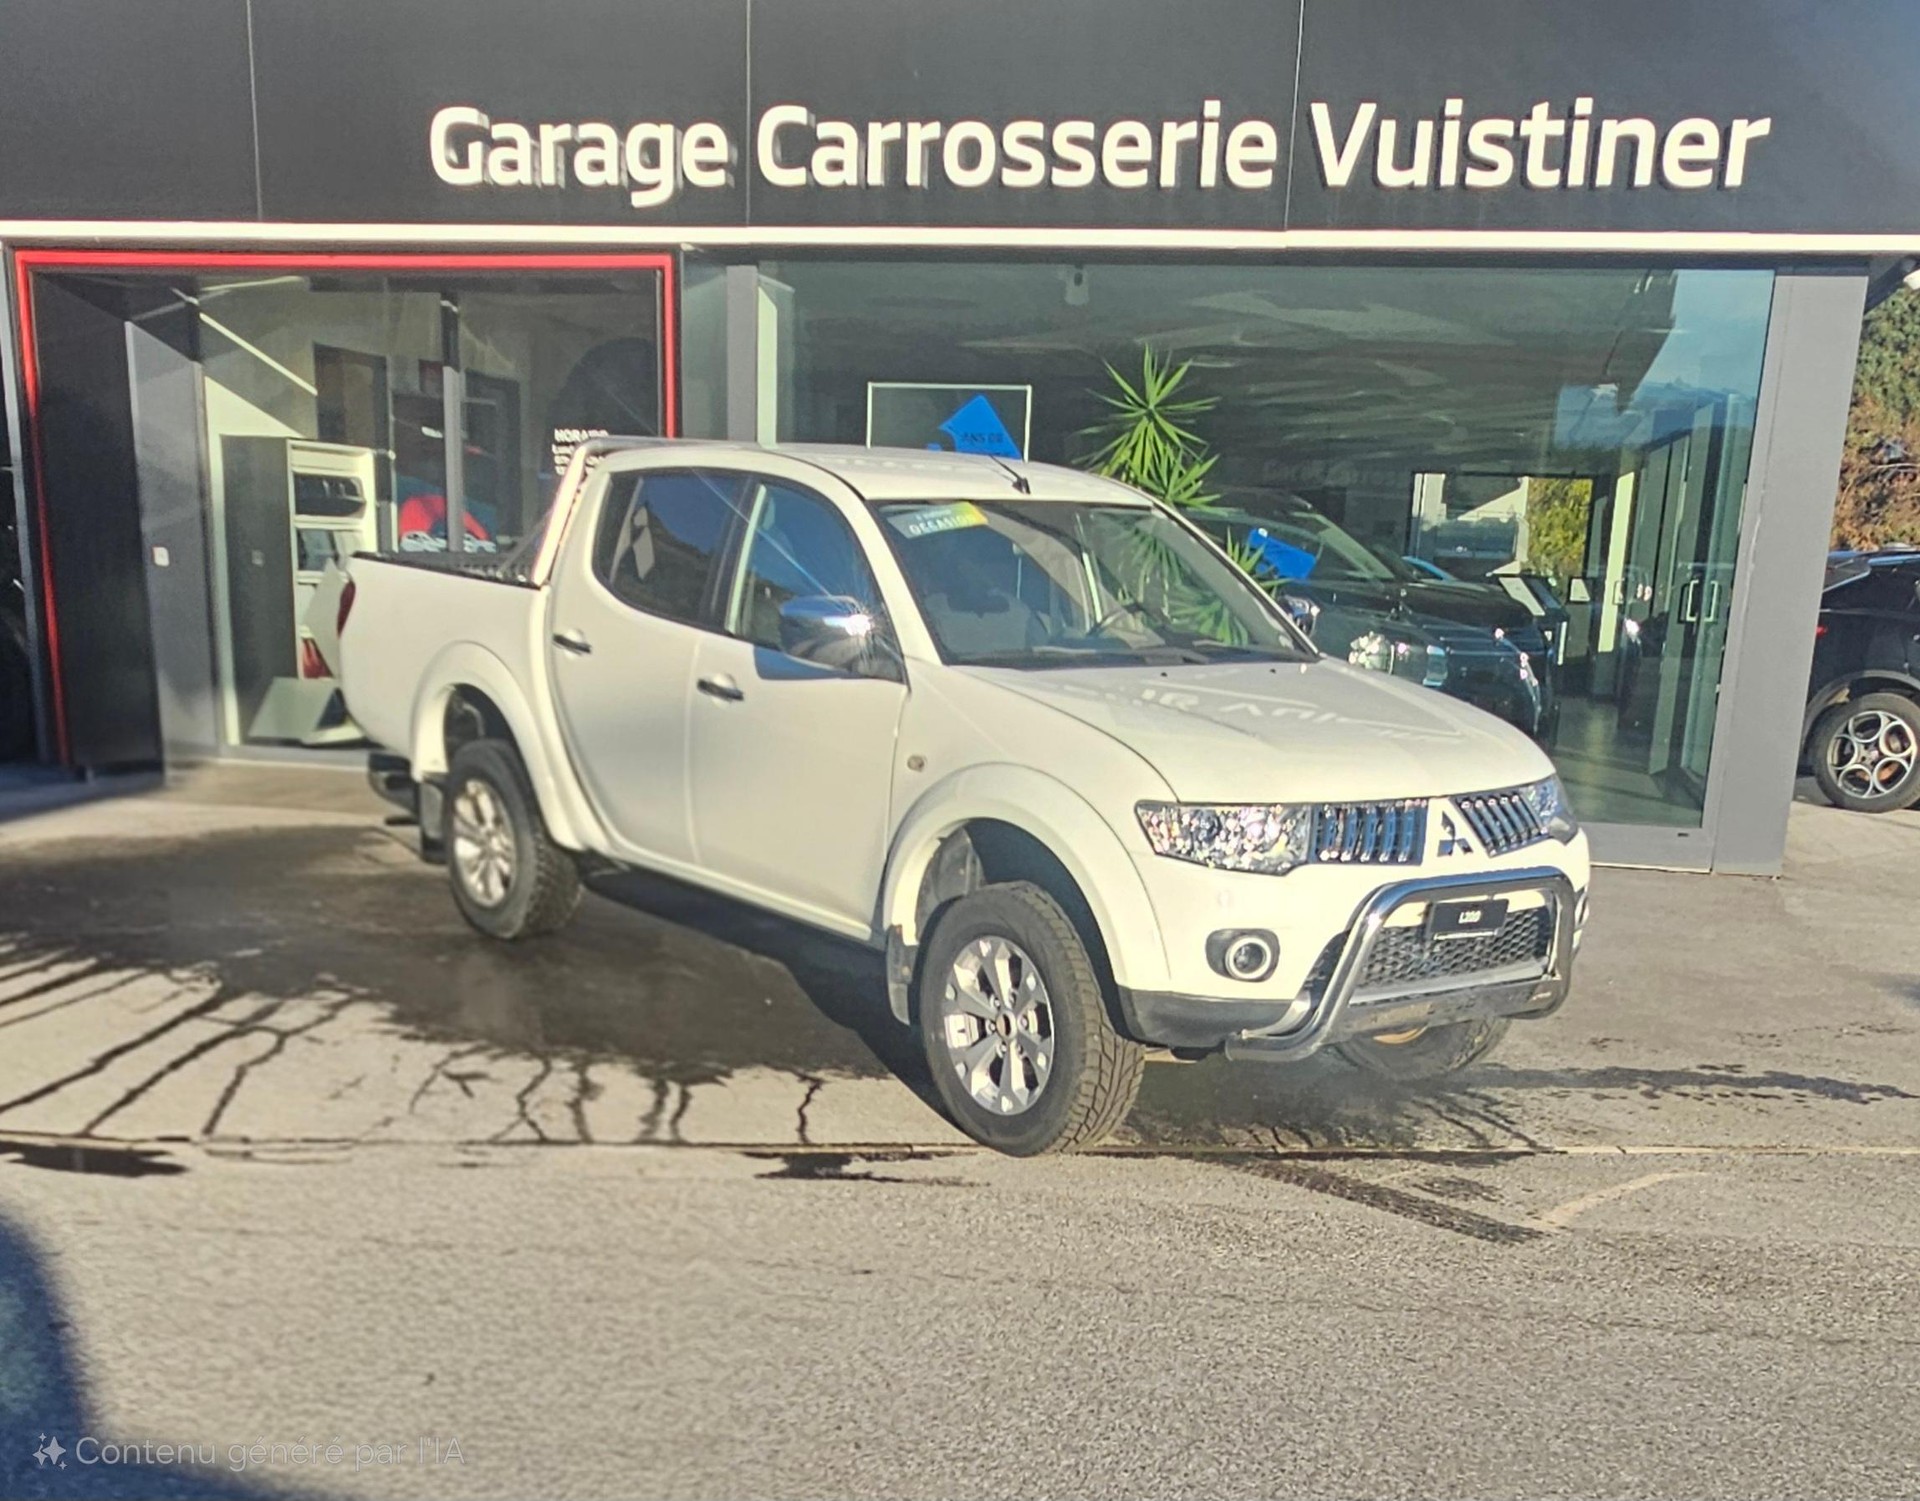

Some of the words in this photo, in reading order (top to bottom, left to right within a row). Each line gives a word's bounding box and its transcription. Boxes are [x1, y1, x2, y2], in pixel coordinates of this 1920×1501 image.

[430, 106, 730, 208] Garage
[757, 100, 1278, 188] Carrosserie
[1310, 97, 1771, 188] Vuistiner
